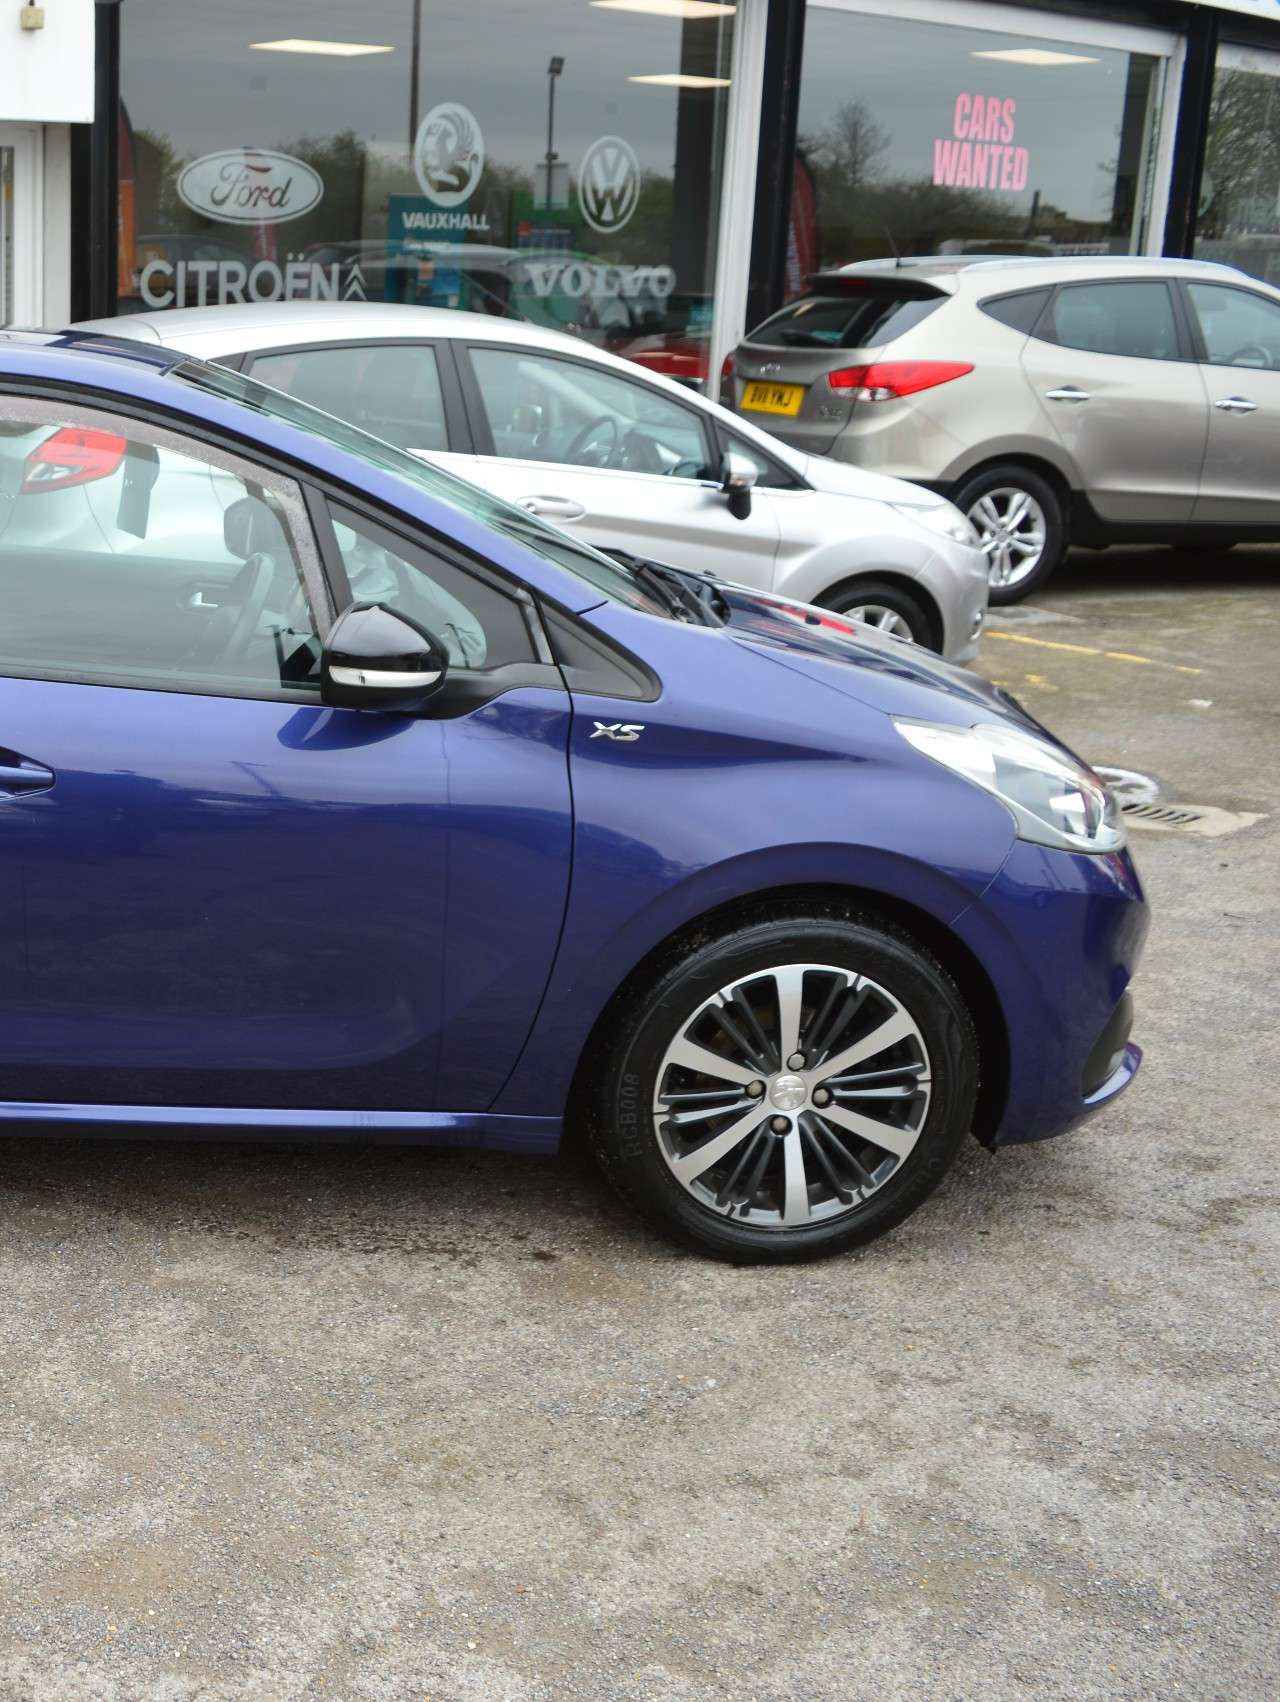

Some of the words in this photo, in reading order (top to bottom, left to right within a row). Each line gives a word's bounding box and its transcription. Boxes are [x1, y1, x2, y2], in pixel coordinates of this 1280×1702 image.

[954, 92, 1016, 143] CARS
[210, 161, 293, 208] Ford
[933, 139, 1029, 191] WANTED
[402, 211, 490, 230] VAUXHALL
[140, 252, 340, 309] CITROËN
[524, 263, 676, 298] VOLVO
[589, 721, 645, 741] XS
